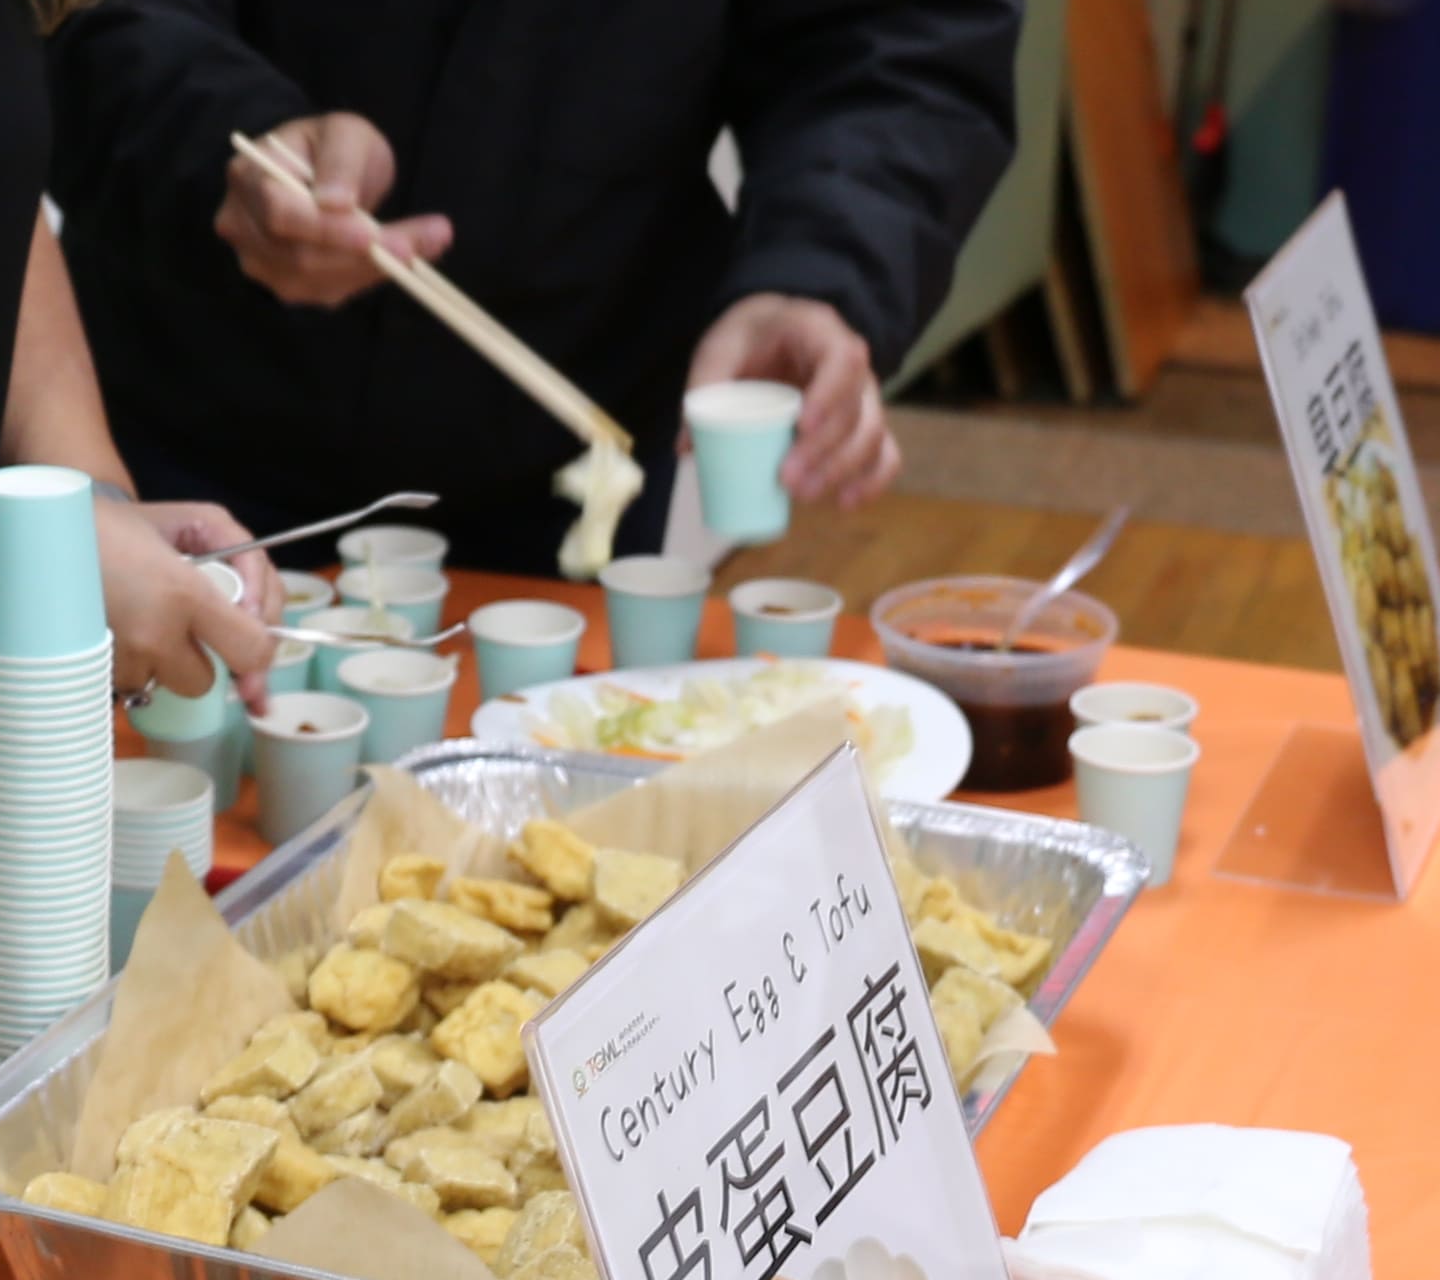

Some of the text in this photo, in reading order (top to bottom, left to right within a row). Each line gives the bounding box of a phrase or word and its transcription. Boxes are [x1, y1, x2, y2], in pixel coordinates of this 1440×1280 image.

[598, 1023, 723, 1165] Century
[722, 970, 782, 1048] Egg
[810, 872, 873, 953] Tofu
